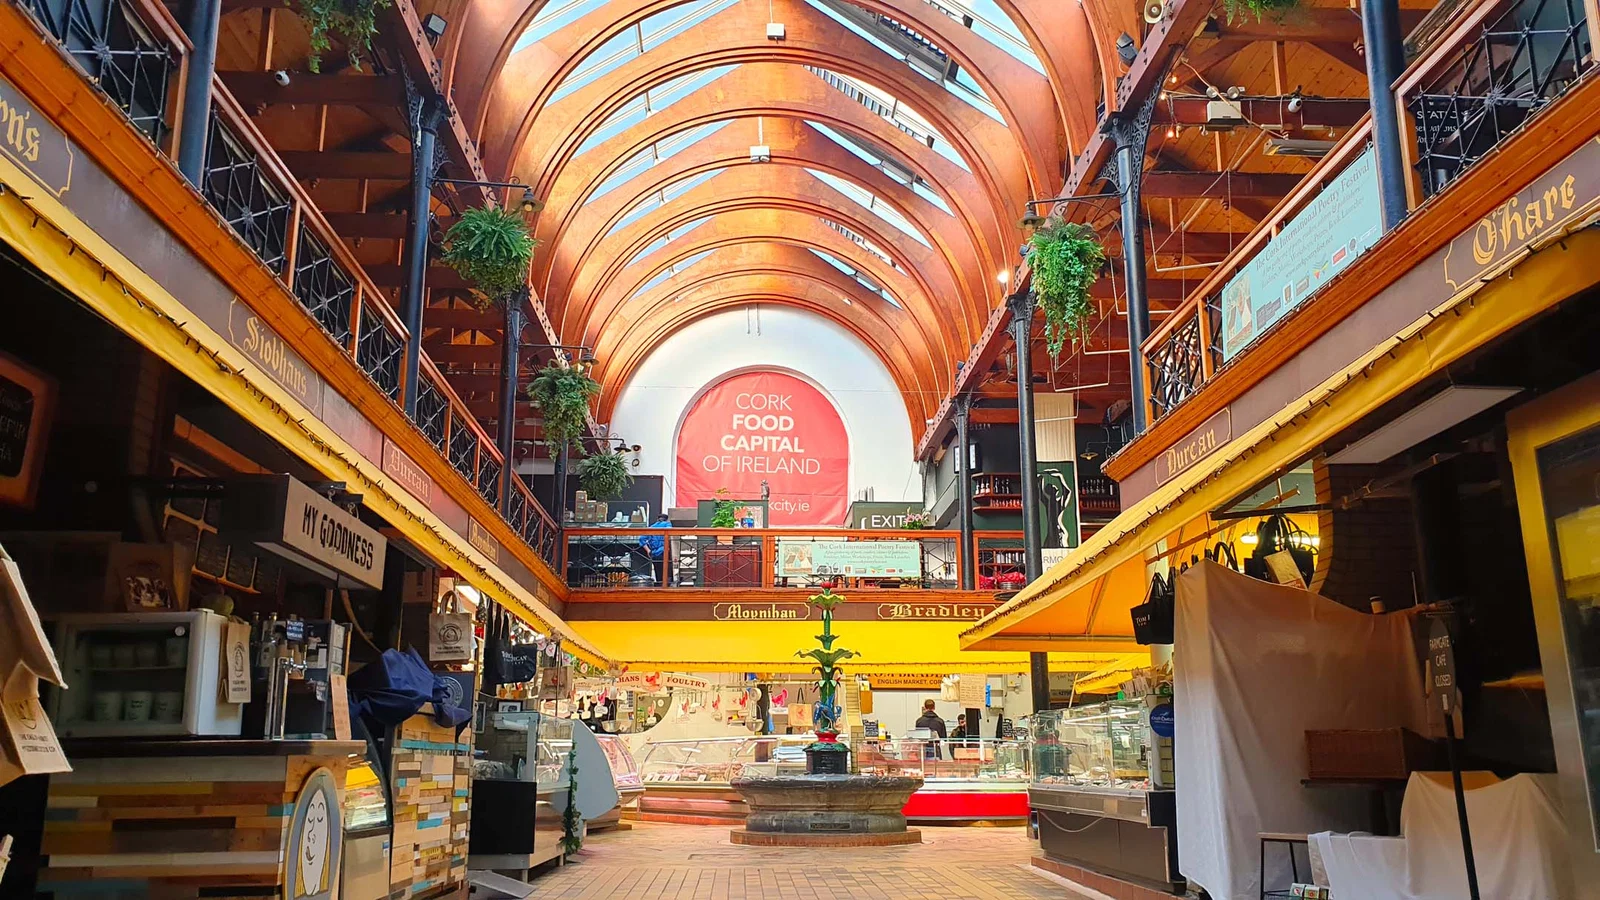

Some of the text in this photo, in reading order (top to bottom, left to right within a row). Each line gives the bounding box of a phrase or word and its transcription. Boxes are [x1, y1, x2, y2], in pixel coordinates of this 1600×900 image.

[1341, 159, 1370, 192] Festival
[736, 393, 793, 411] CORK
[732, 414, 794, 431] FOOD
[720, 434, 805, 453] CAPITAL
[1166, 428, 1216, 477] Durcan
[387, 450, 429, 497] Durcan
[703, 455, 820, 475] OF IRELAND
[871, 515, 907, 528] EXIT
[302, 502, 374, 571] MY GOODNESS
[726, 603, 985, 620] Moynihan Bradley
[666, 676, 708, 688] POULTRY
